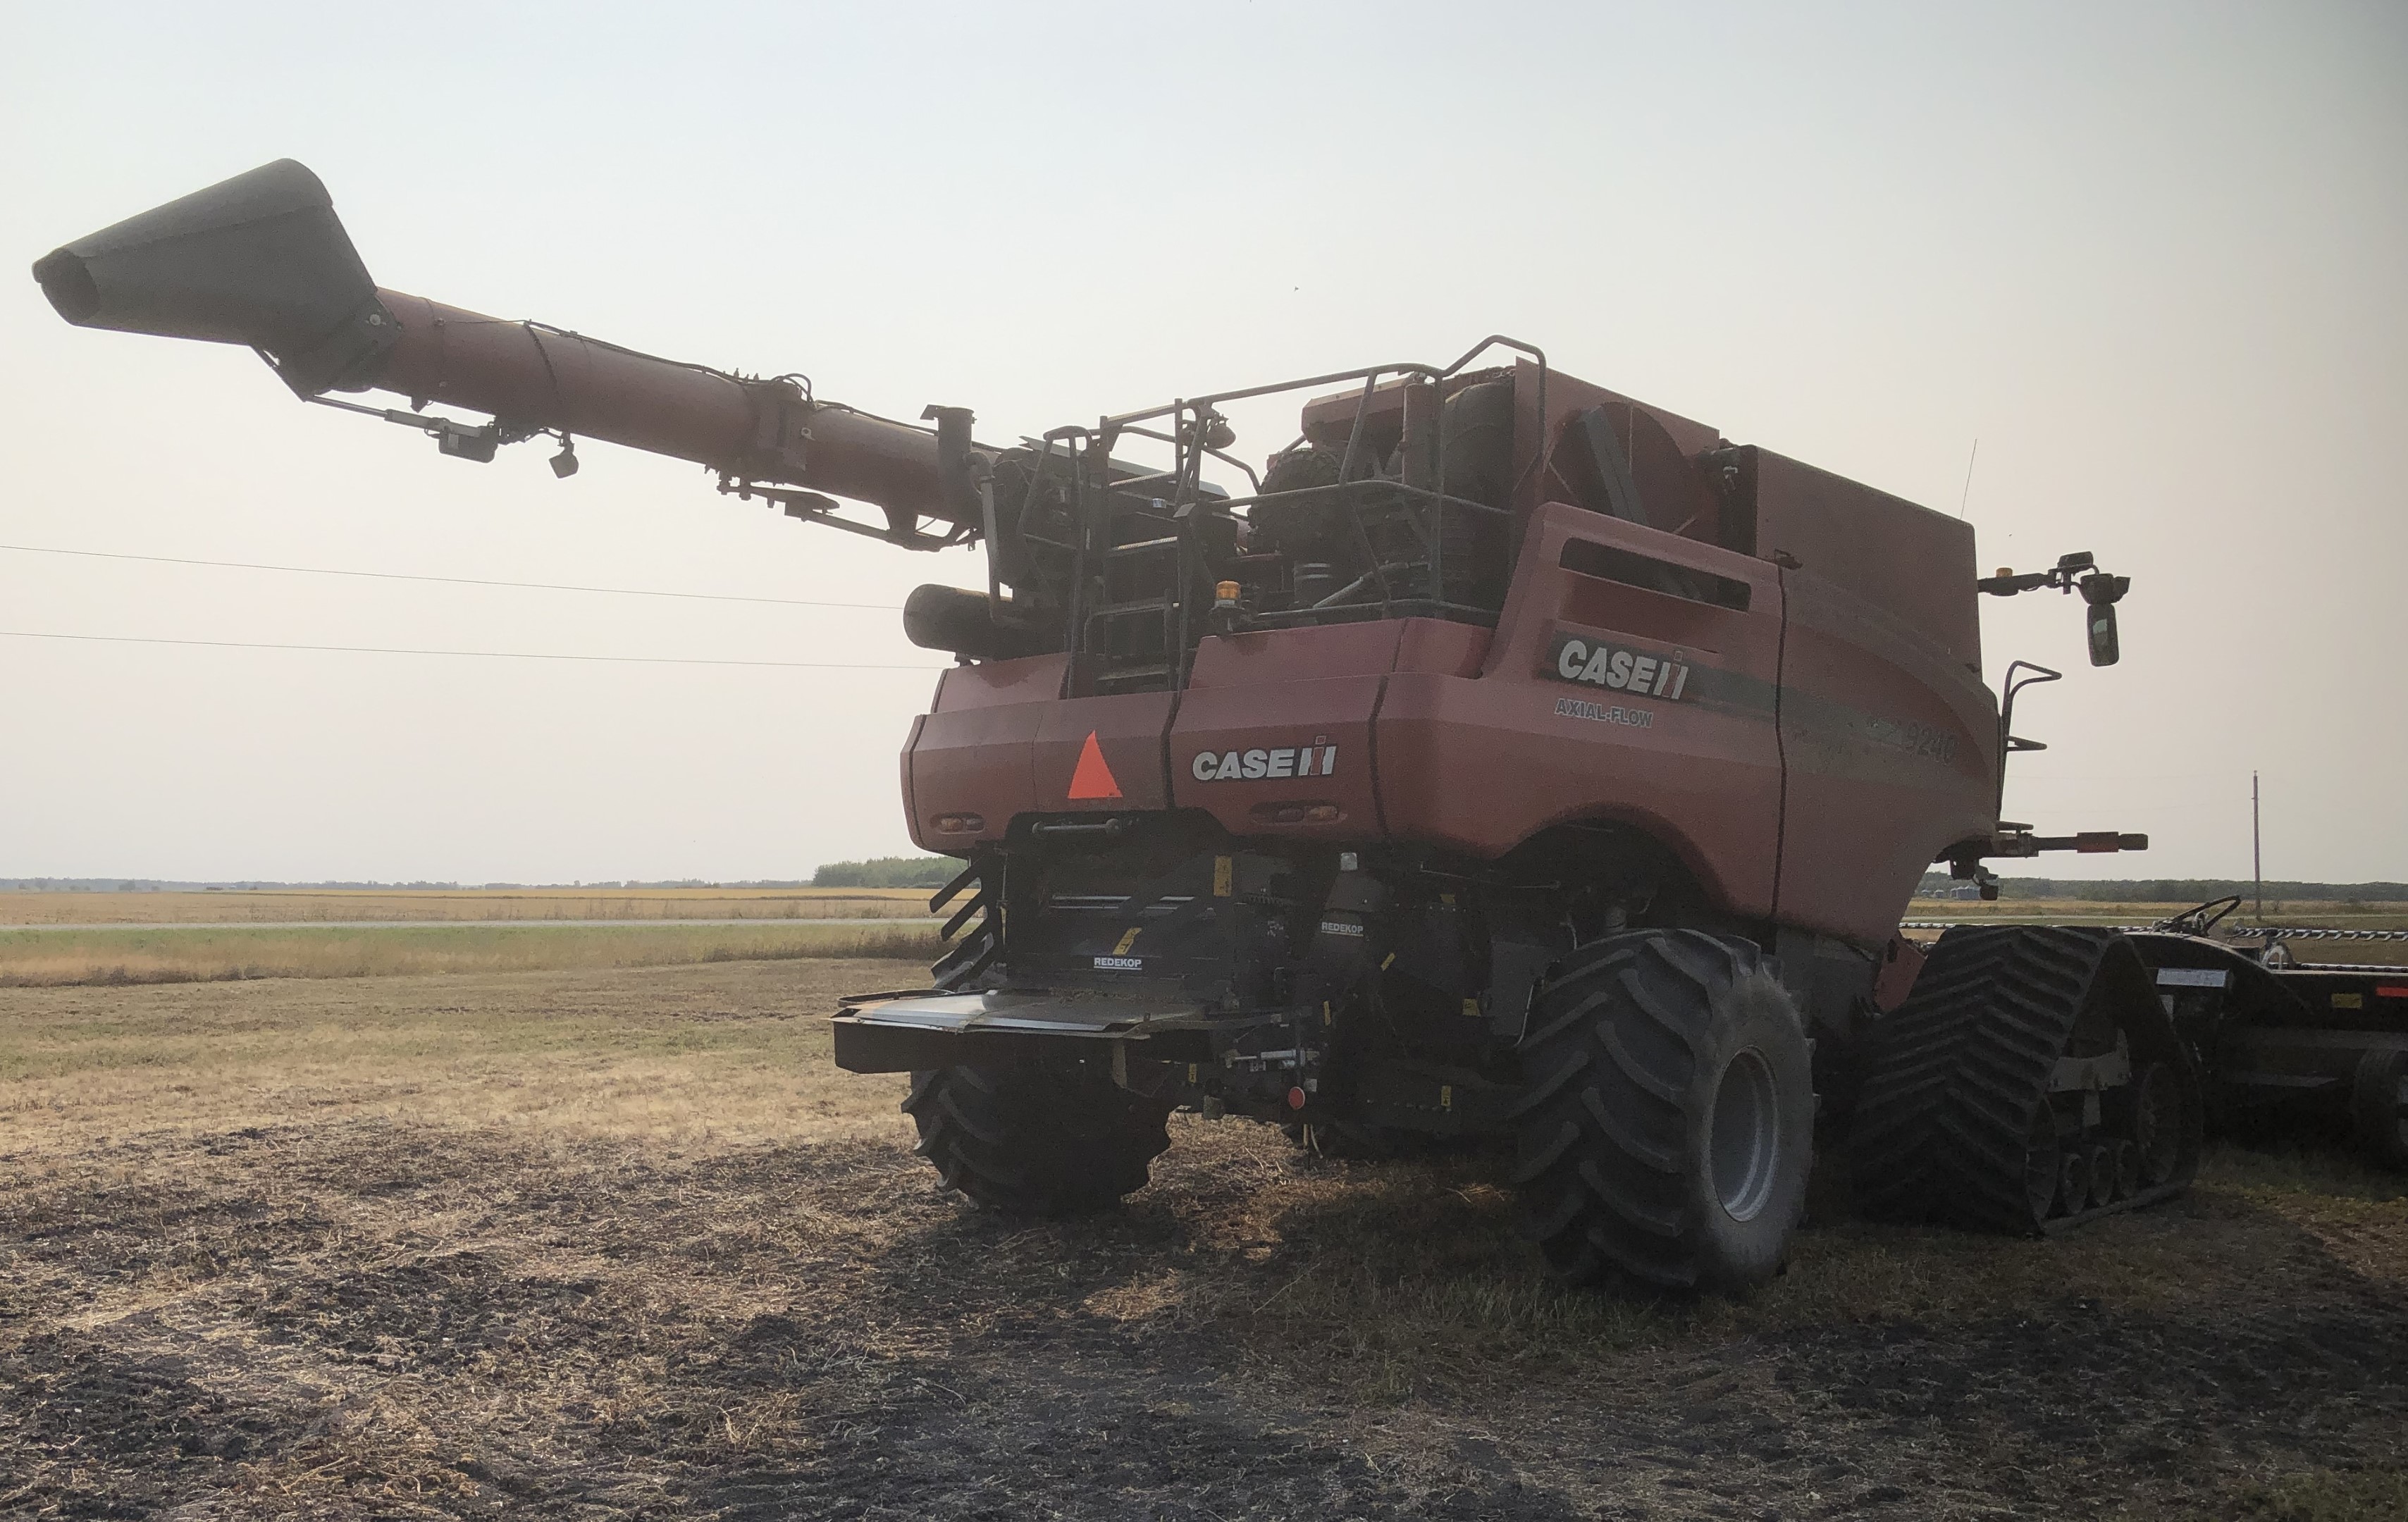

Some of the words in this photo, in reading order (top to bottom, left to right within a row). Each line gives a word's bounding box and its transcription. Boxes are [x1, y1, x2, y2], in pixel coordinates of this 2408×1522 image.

[1554, 698, 1654, 729] AXIAL-FLOW
[1321, 921, 1364, 934] REDEKOP
[1094, 957, 1142, 967] REDEKOP
